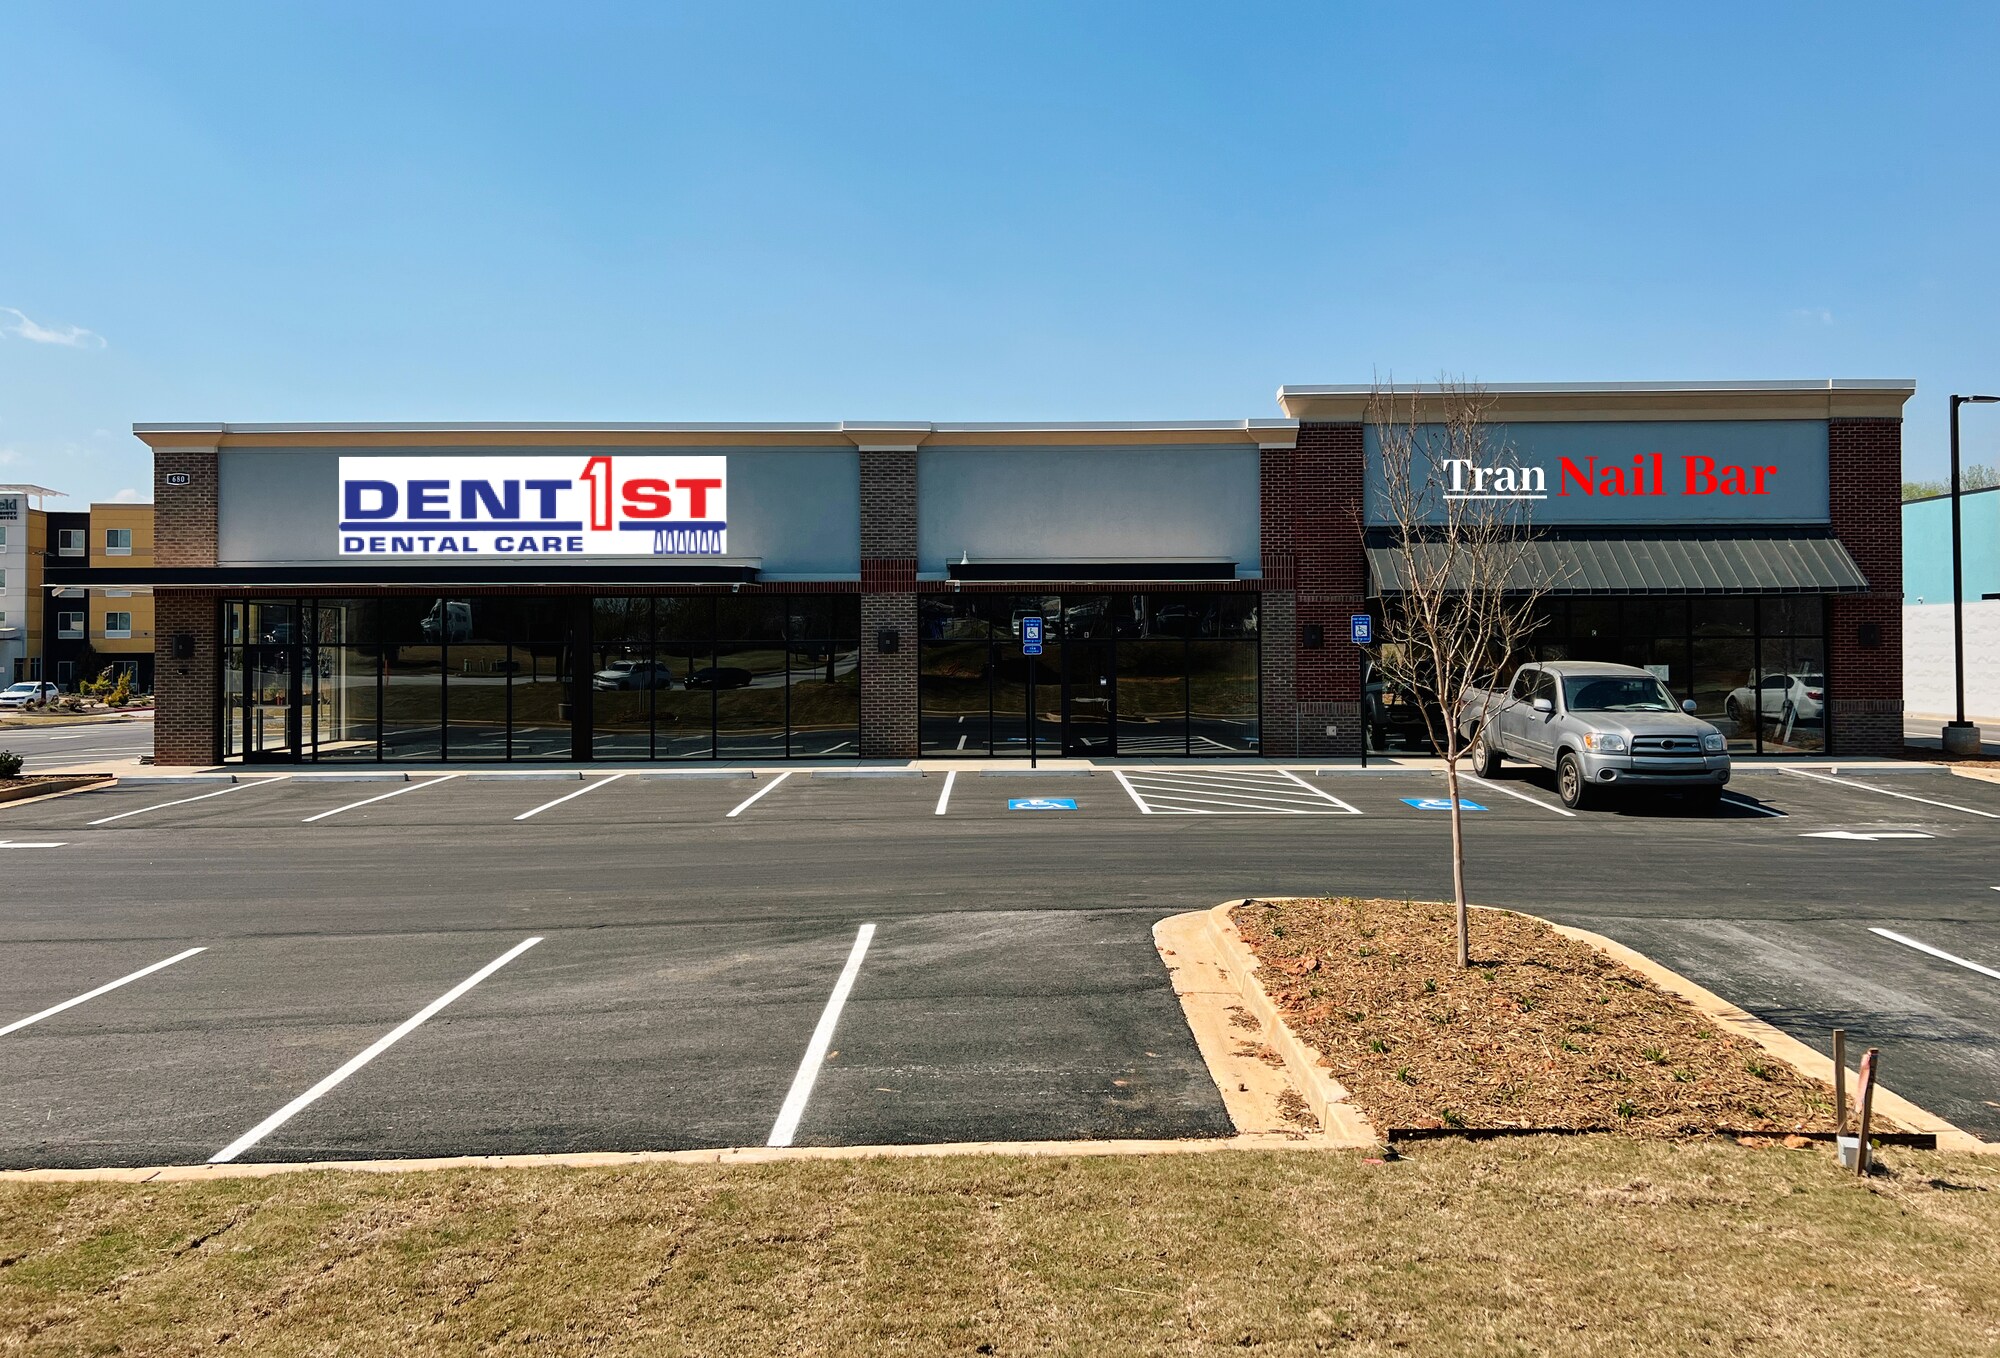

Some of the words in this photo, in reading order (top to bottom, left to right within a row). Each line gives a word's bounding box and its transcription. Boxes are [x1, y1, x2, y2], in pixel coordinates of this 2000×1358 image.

[172, 475, 185, 483] 680
[1443, 459, 1547, 492] Tran
[1556, 453, 1667, 496] Nail
[1681, 455, 1777, 495] Bar
[344, 536, 478, 552] DENTAL
[494, 536, 583, 552] CARE
